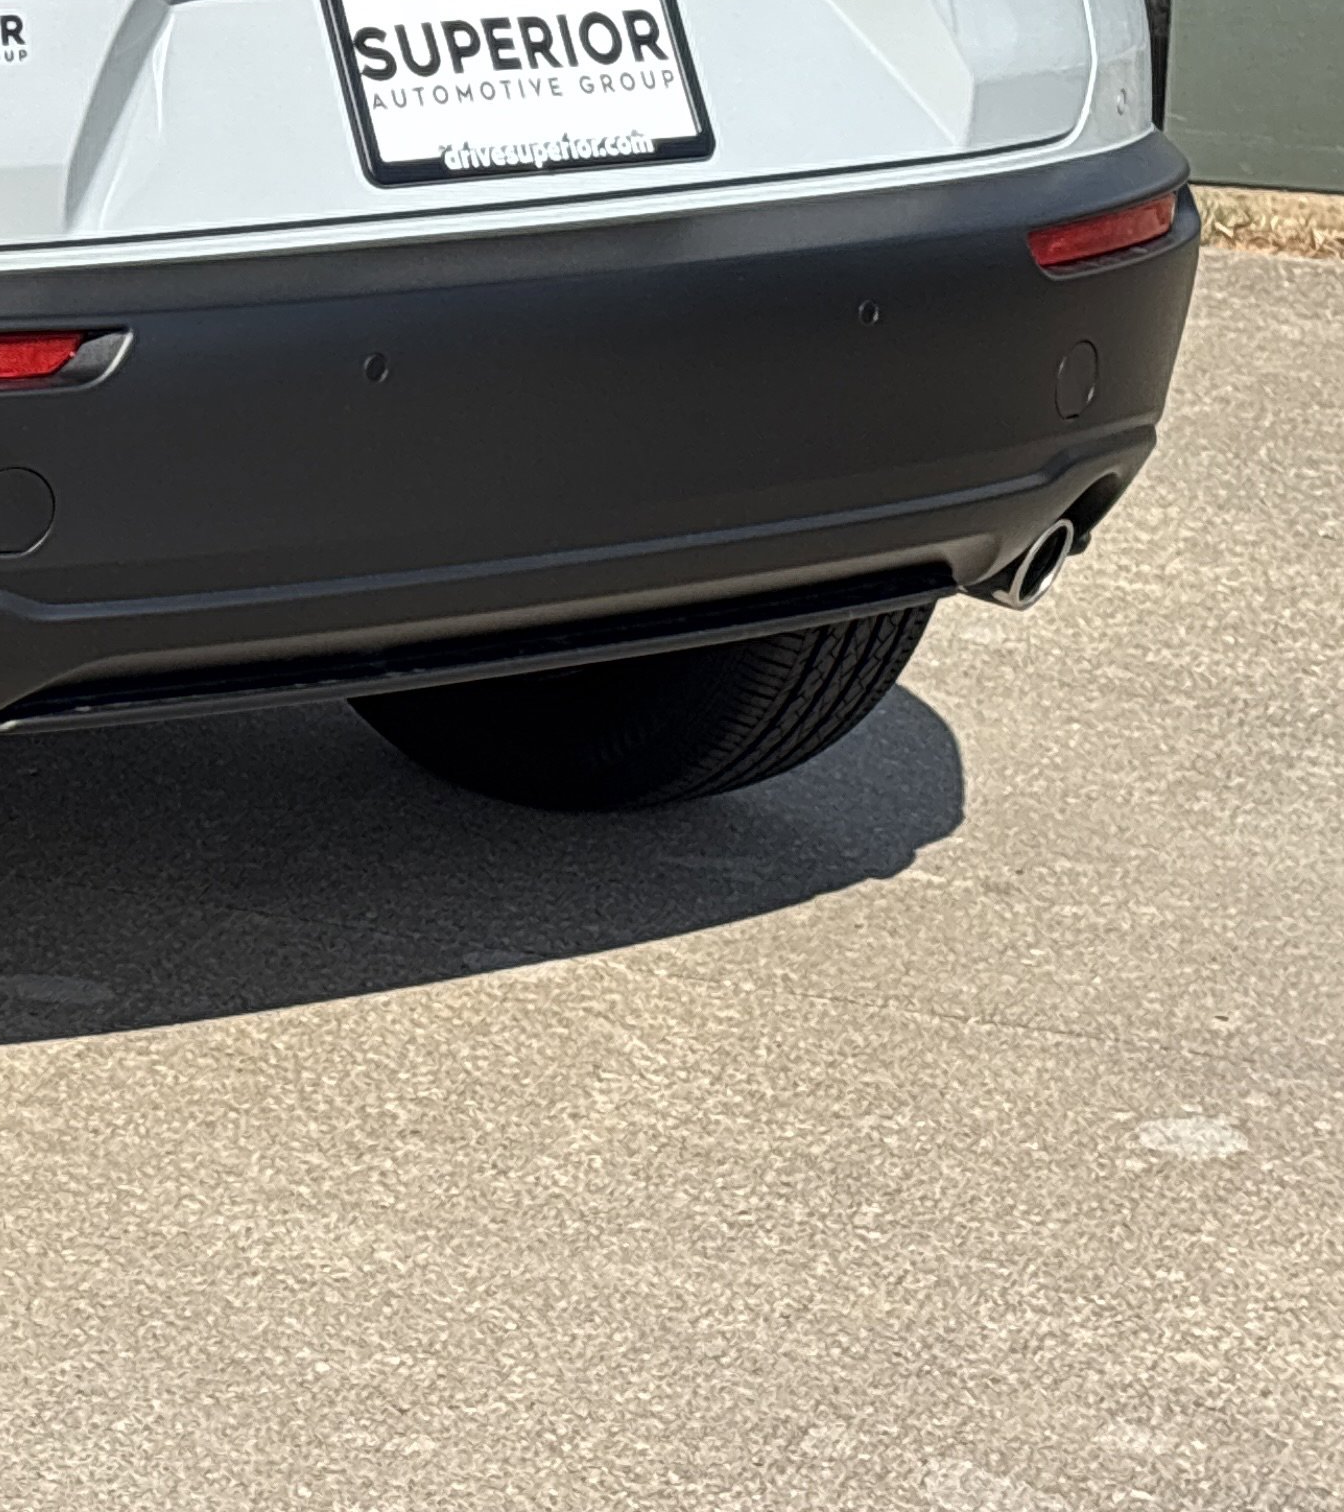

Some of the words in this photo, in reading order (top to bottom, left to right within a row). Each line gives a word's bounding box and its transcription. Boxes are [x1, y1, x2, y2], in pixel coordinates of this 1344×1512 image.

[353, 10, 669, 81] SUPERIOR
[373, 76, 562, 110] AUTOMOTIVE
[579, 69, 675, 94] GROUP
[440, 131, 654, 170] drivesuperior.com
